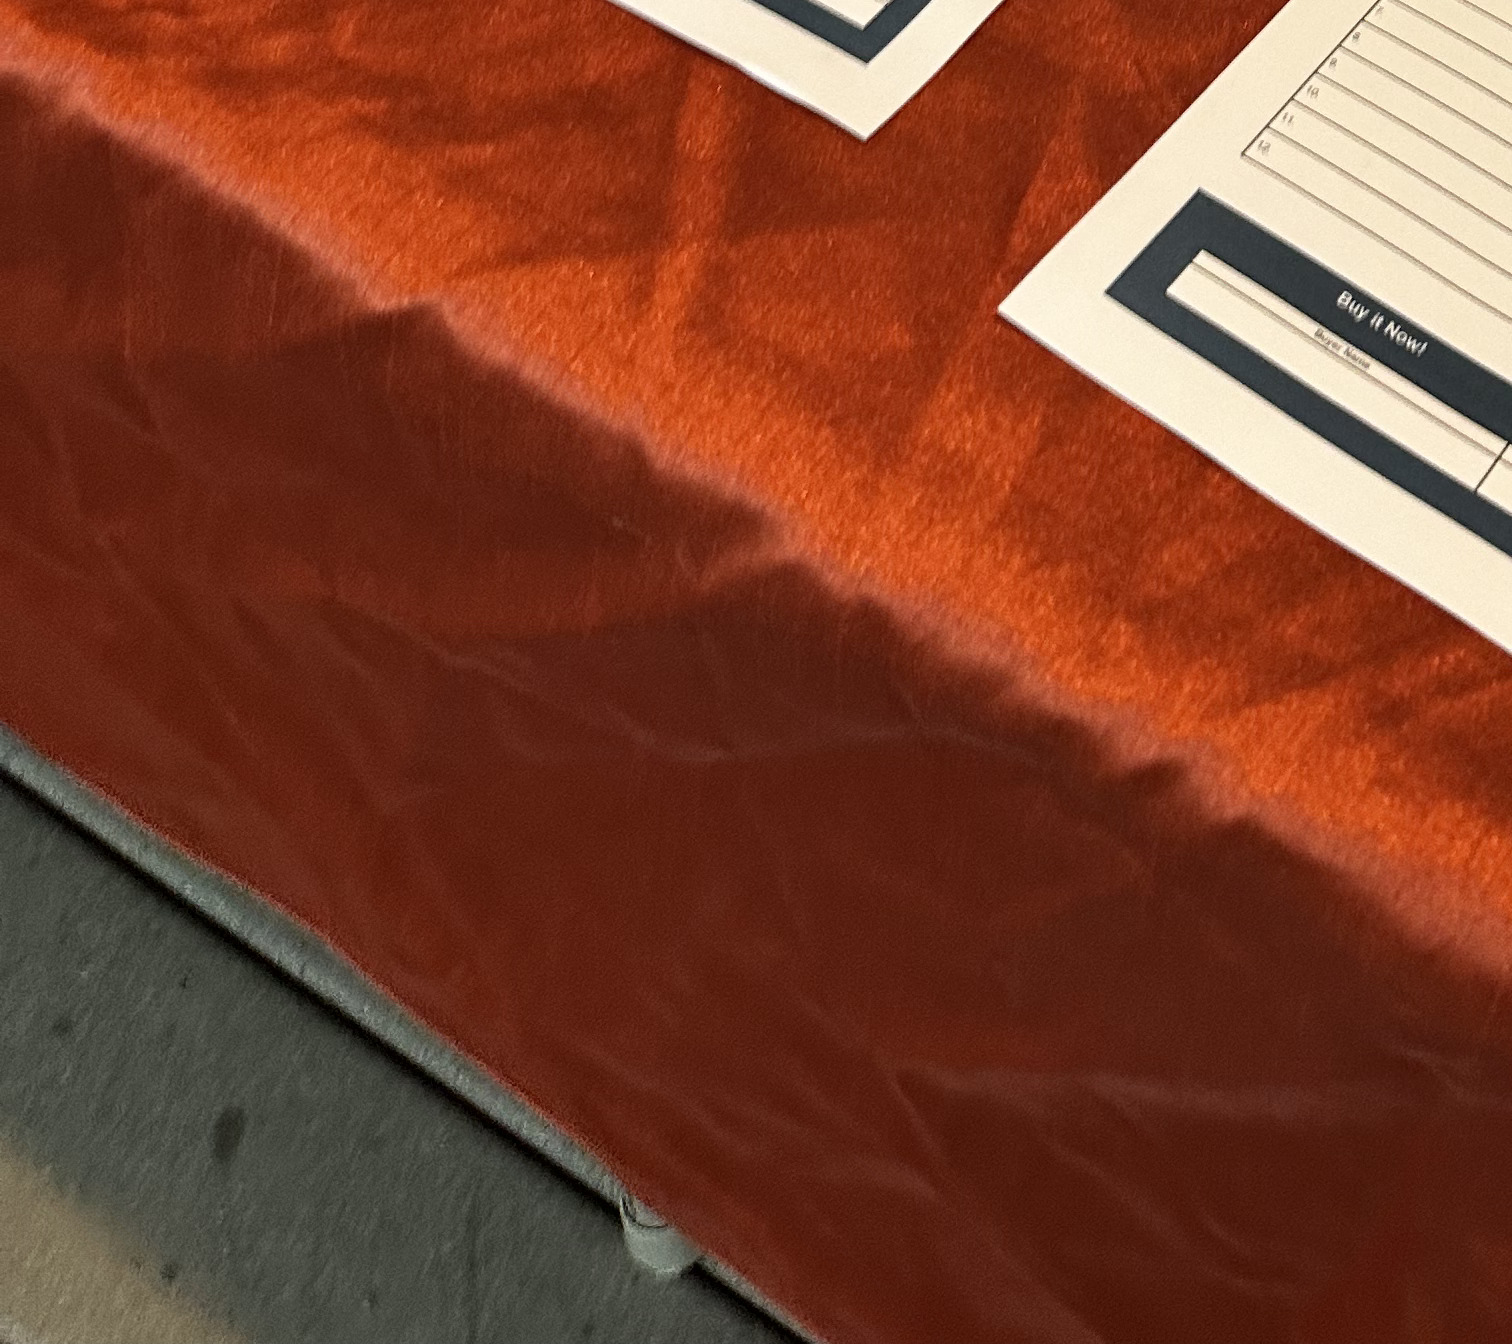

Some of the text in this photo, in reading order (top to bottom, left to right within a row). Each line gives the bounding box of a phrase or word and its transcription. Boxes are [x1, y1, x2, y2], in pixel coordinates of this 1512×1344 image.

[1337, 290, 1429, 357] Buy it Now!
